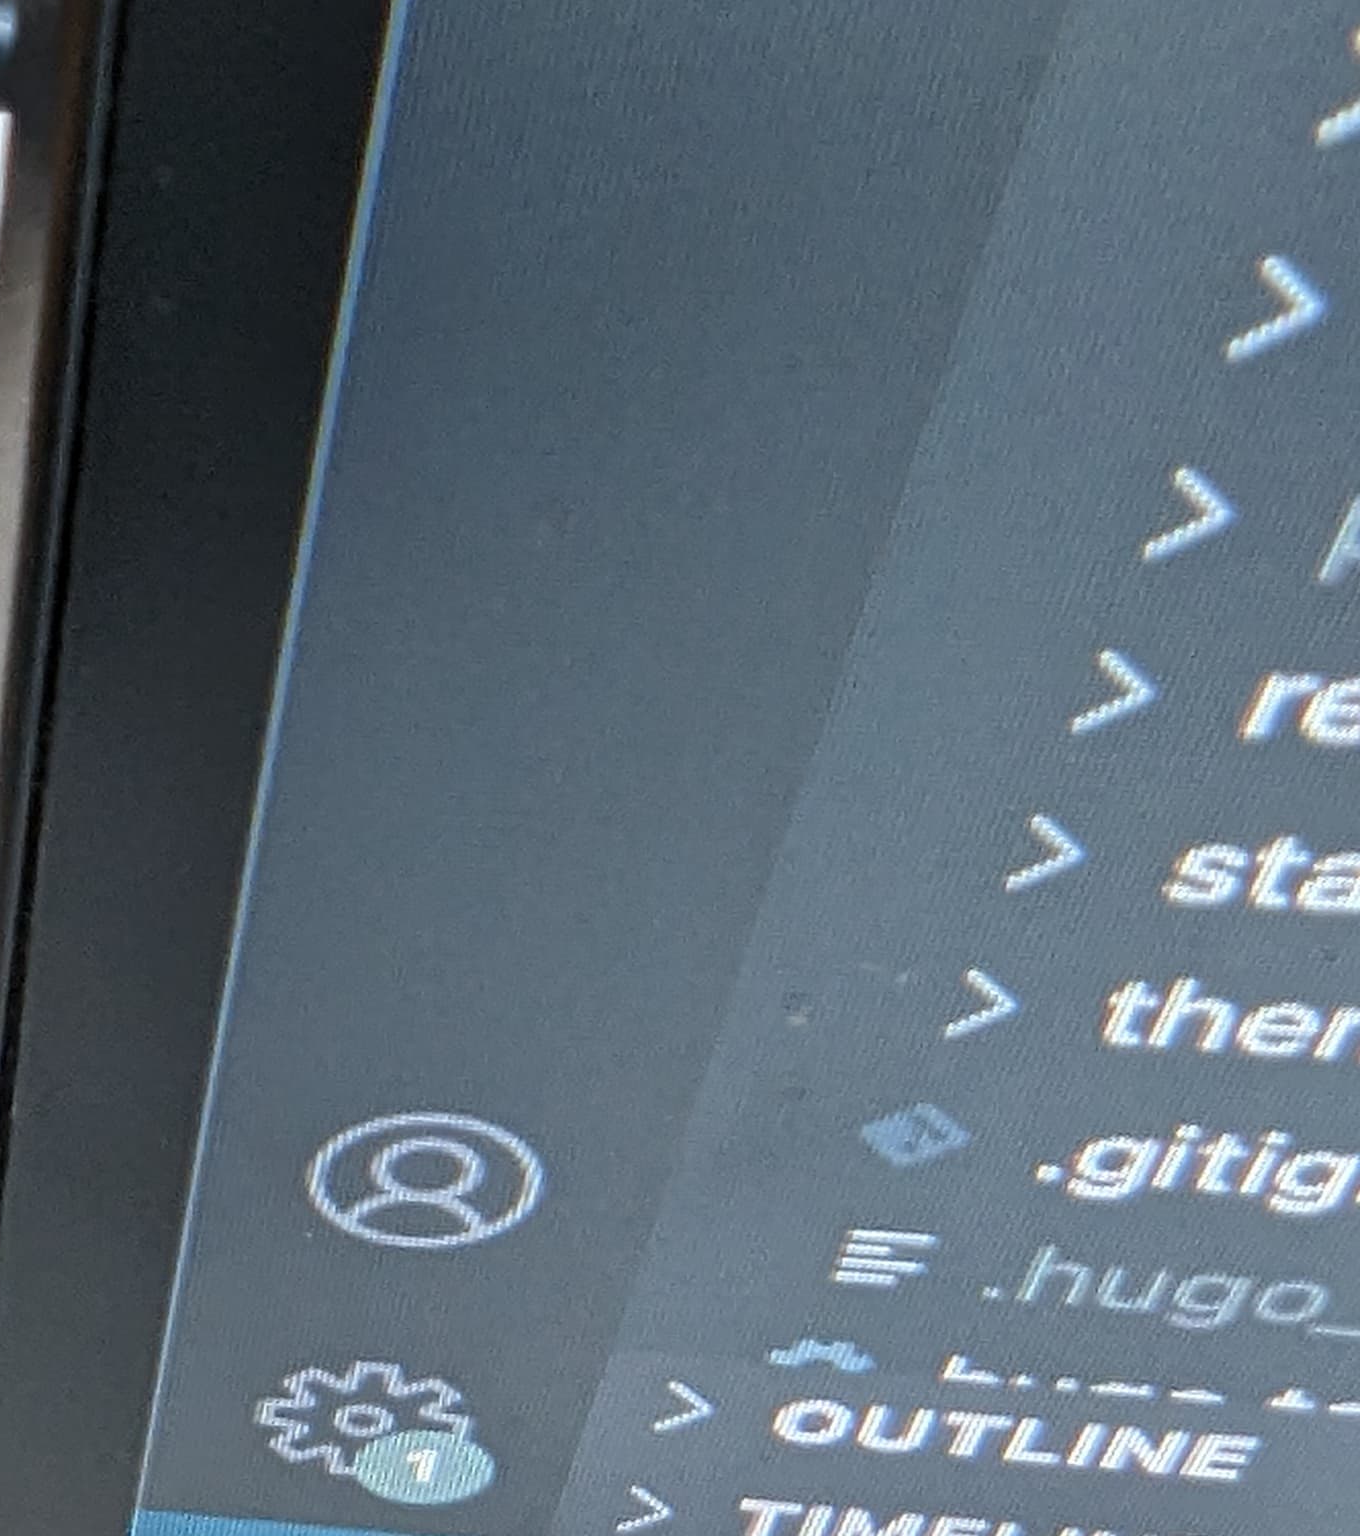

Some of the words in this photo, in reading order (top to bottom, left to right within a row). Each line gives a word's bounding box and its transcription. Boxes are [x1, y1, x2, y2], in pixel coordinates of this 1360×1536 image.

[1160, 833, 1360, 914] sta
[1035, 1122, 1360, 1216] .gitig
[407, 1448, 438, 1483] 1
[772, 1396, 1264, 1483] OUTLINE
